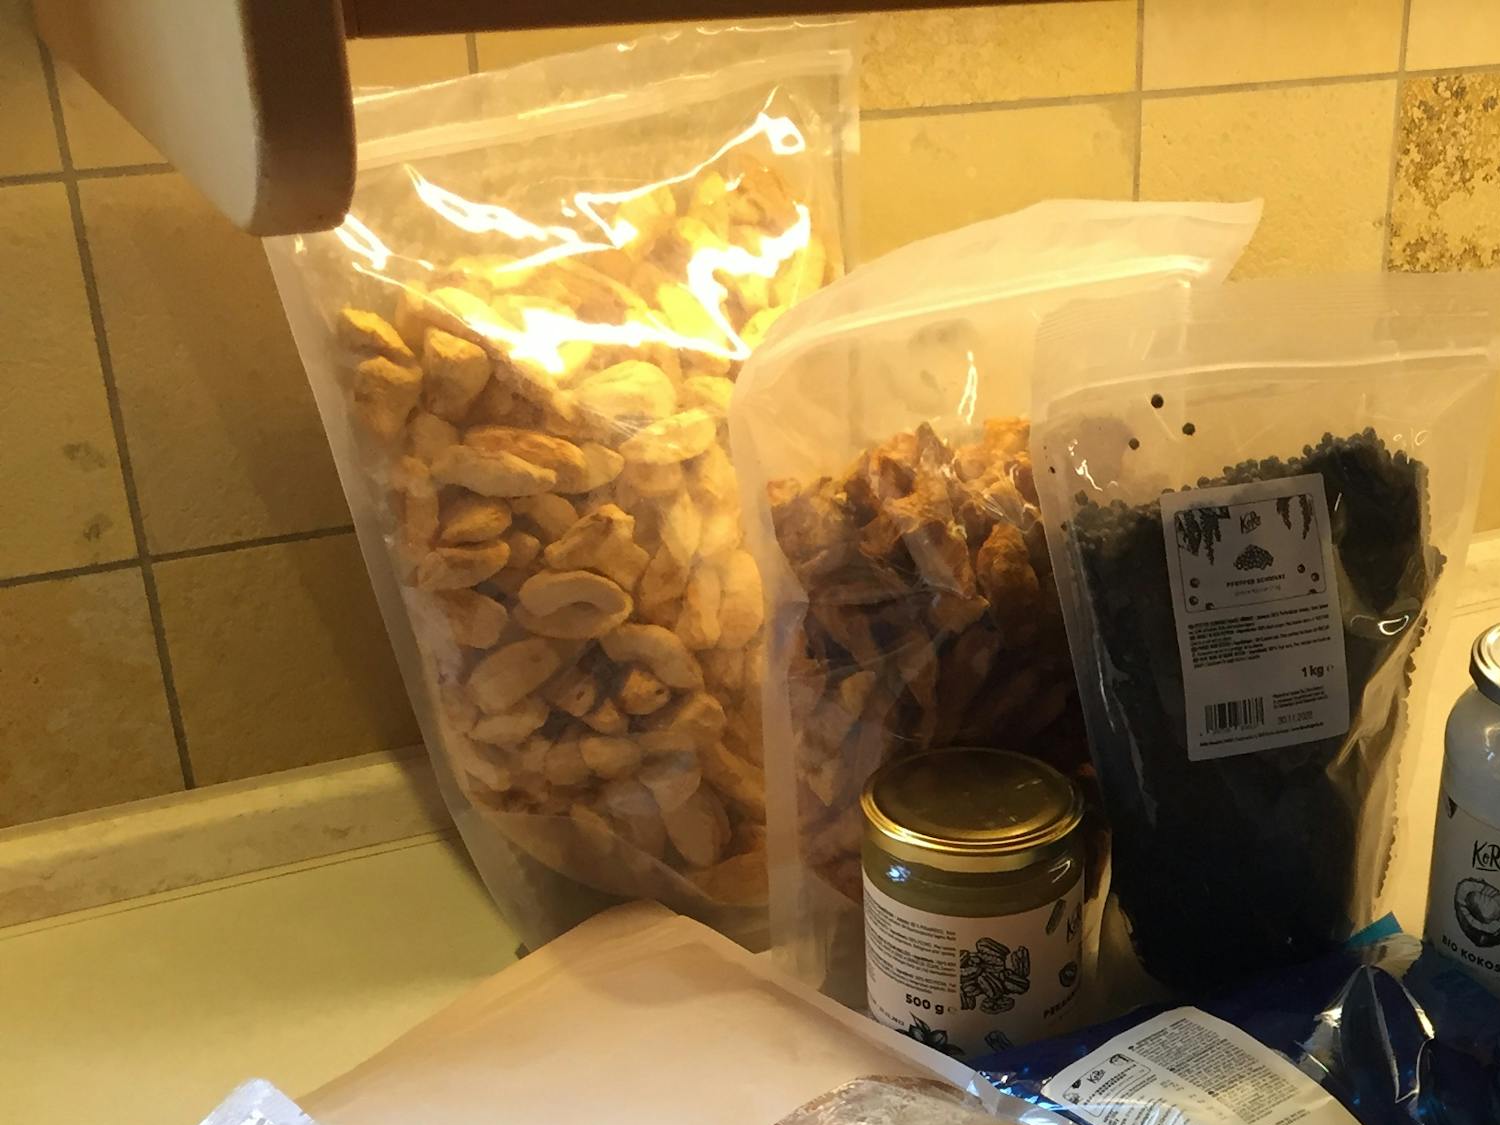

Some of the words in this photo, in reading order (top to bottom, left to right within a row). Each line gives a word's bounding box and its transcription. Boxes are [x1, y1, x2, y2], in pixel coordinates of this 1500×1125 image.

[1301, 666, 1308, 678] 1
[1310, 664, 1325, 678] kg
[1441, 934, 1458, 952] BIO
[905, 993, 931, 1010] 500
[935, 1004, 945, 1015] g
